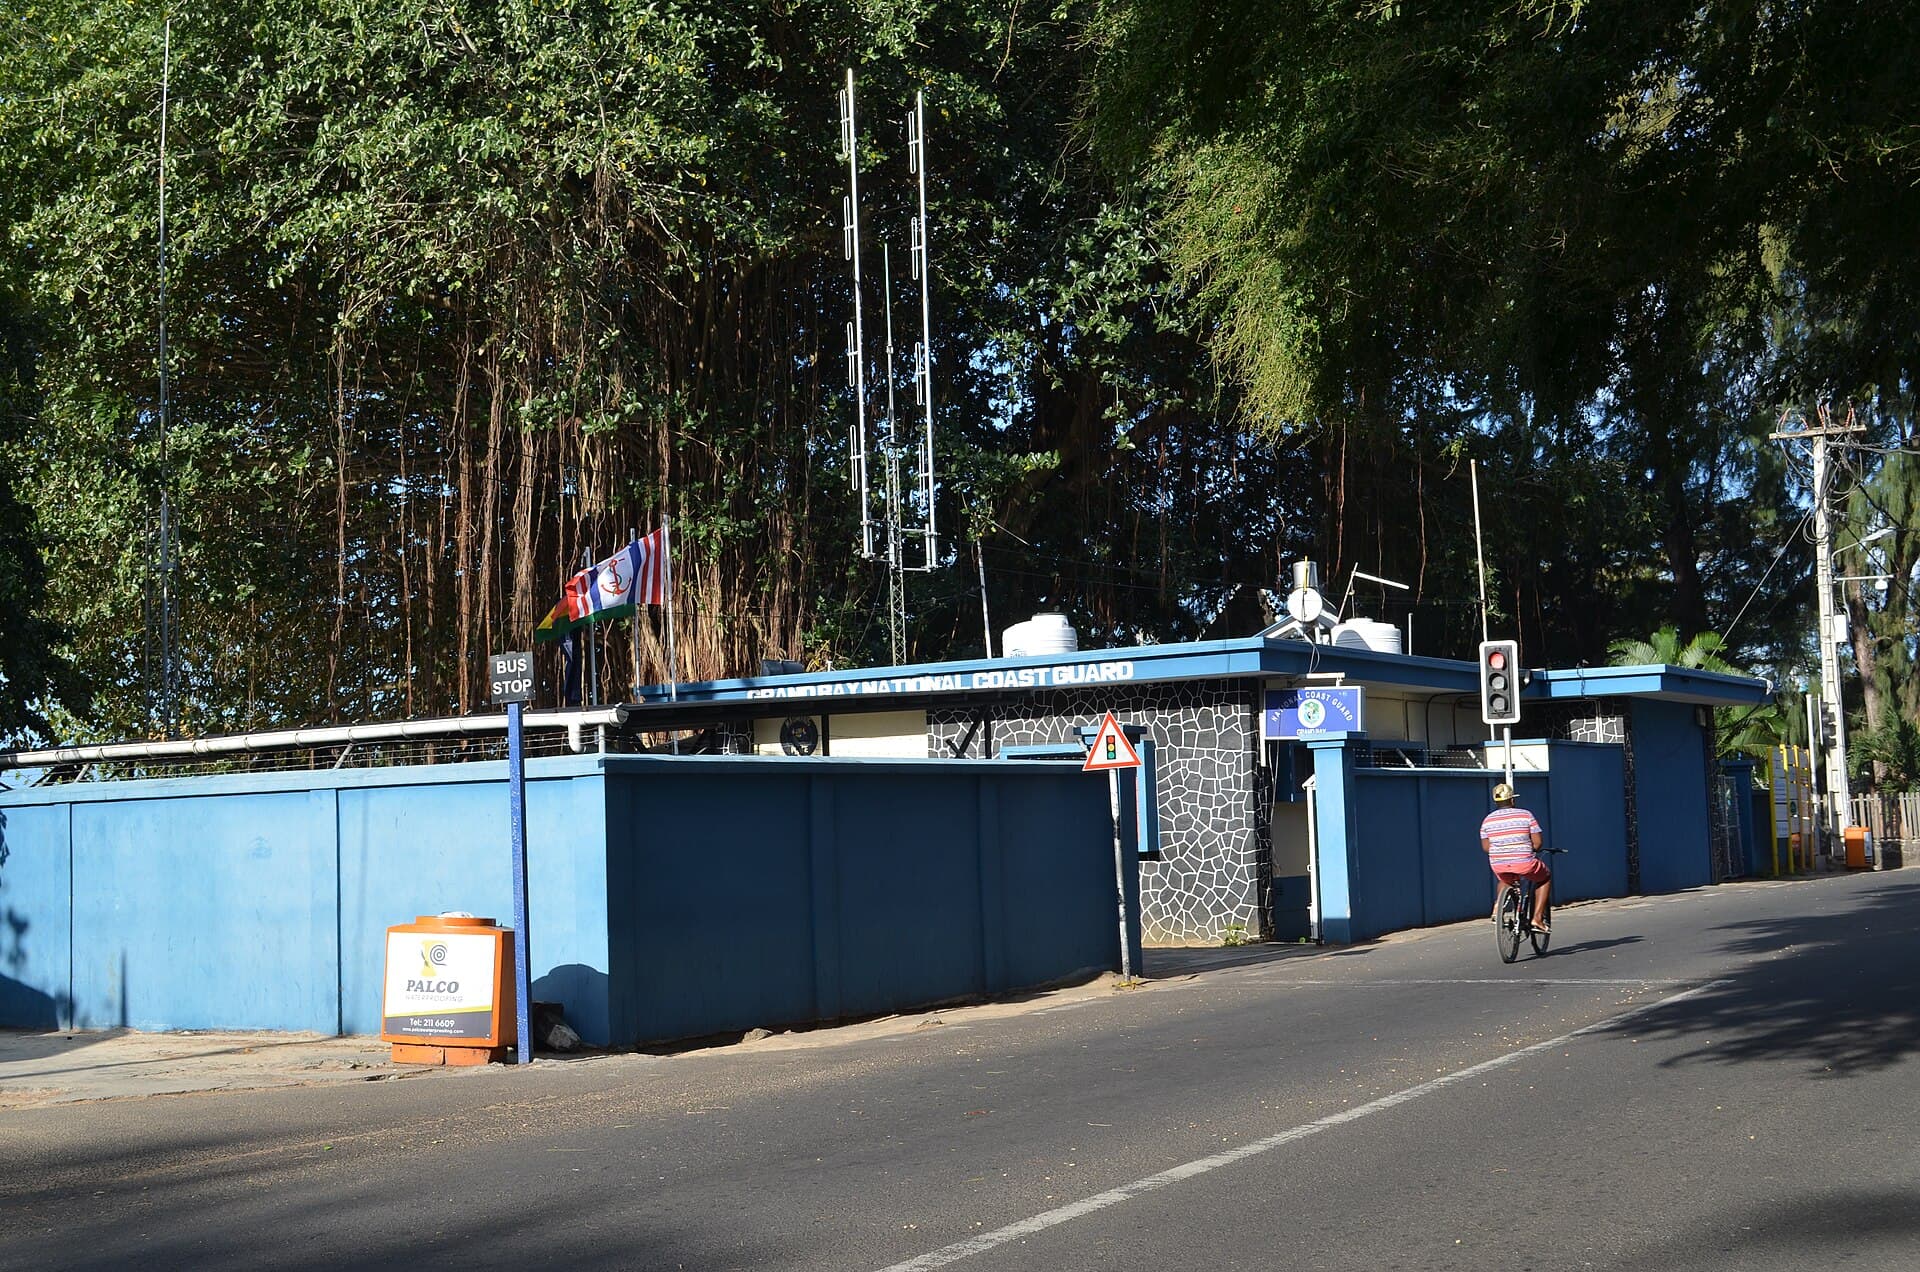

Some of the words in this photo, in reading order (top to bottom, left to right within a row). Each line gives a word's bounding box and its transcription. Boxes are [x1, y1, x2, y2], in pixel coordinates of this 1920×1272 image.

[496, 658, 527, 674] BUS
[861, 674, 968, 693] NATIONAL
[972, 668, 1050, 689] COAST
[1052, 661, 1134, 685] GUARD
[492, 679, 532, 695] STOP
[1305, 691, 1331, 702] COAST
[1331, 698, 1353, 721] GUARD
[406, 979, 460, 993] PALCO
[410, 1018, 422, 1026] Tel:
[423, 1019, 434, 1027] 211
[435, 1020, 455, 1028] 6609
